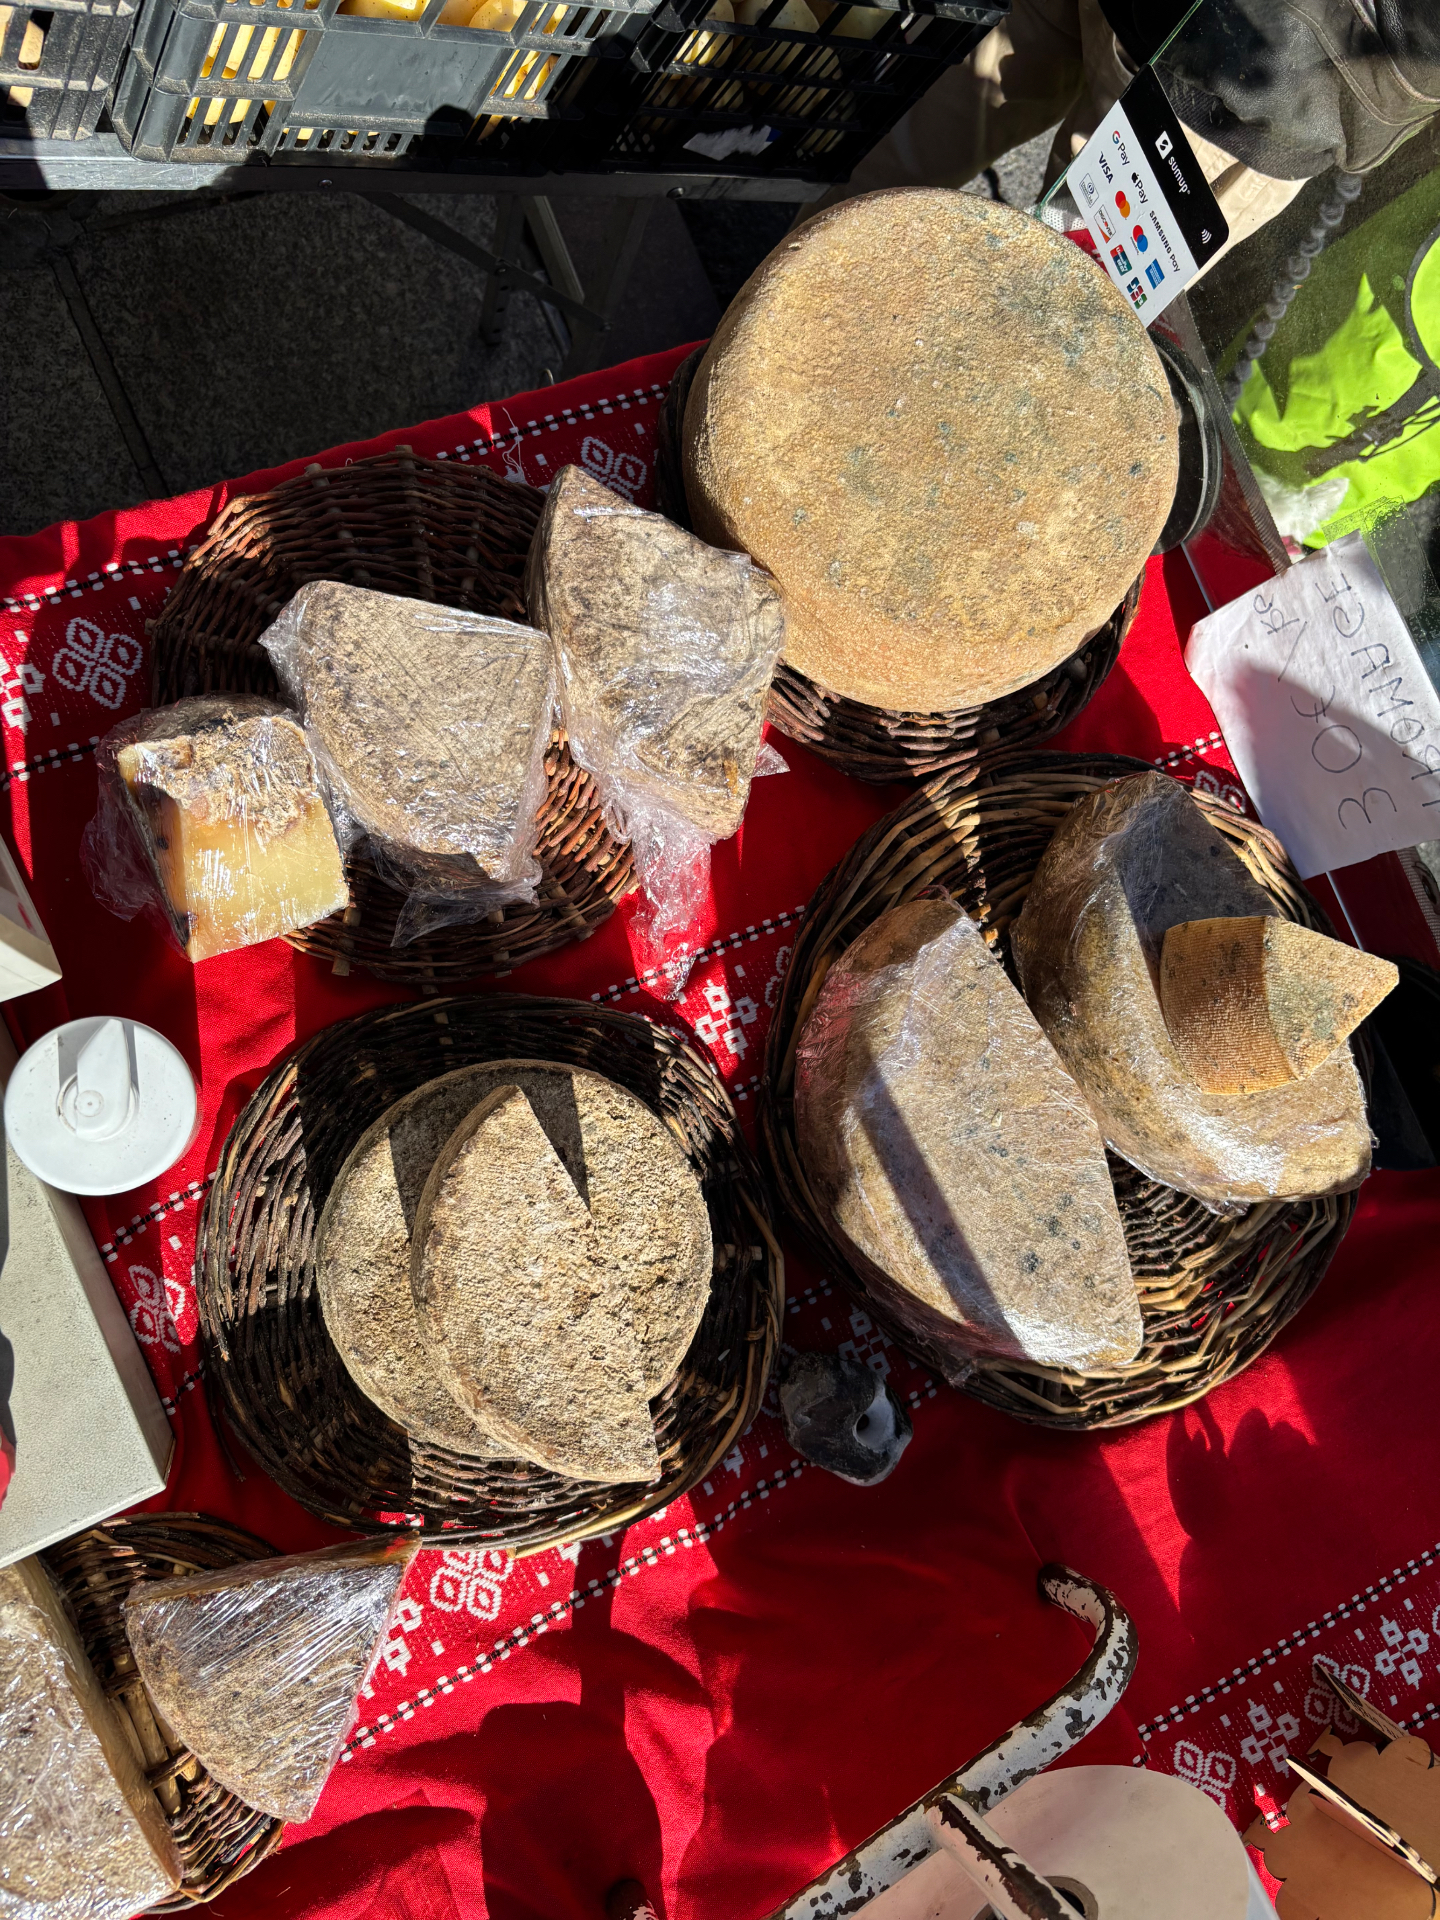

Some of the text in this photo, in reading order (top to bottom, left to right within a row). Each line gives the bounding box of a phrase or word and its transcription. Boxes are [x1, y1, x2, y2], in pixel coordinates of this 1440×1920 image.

[1098, 151, 1113, 184] VISA
[1117, 142, 1130, 165] Pay
[1135, 179, 1148, 203] Pay
[1149, 210, 1172, 254] SAMSUNG
